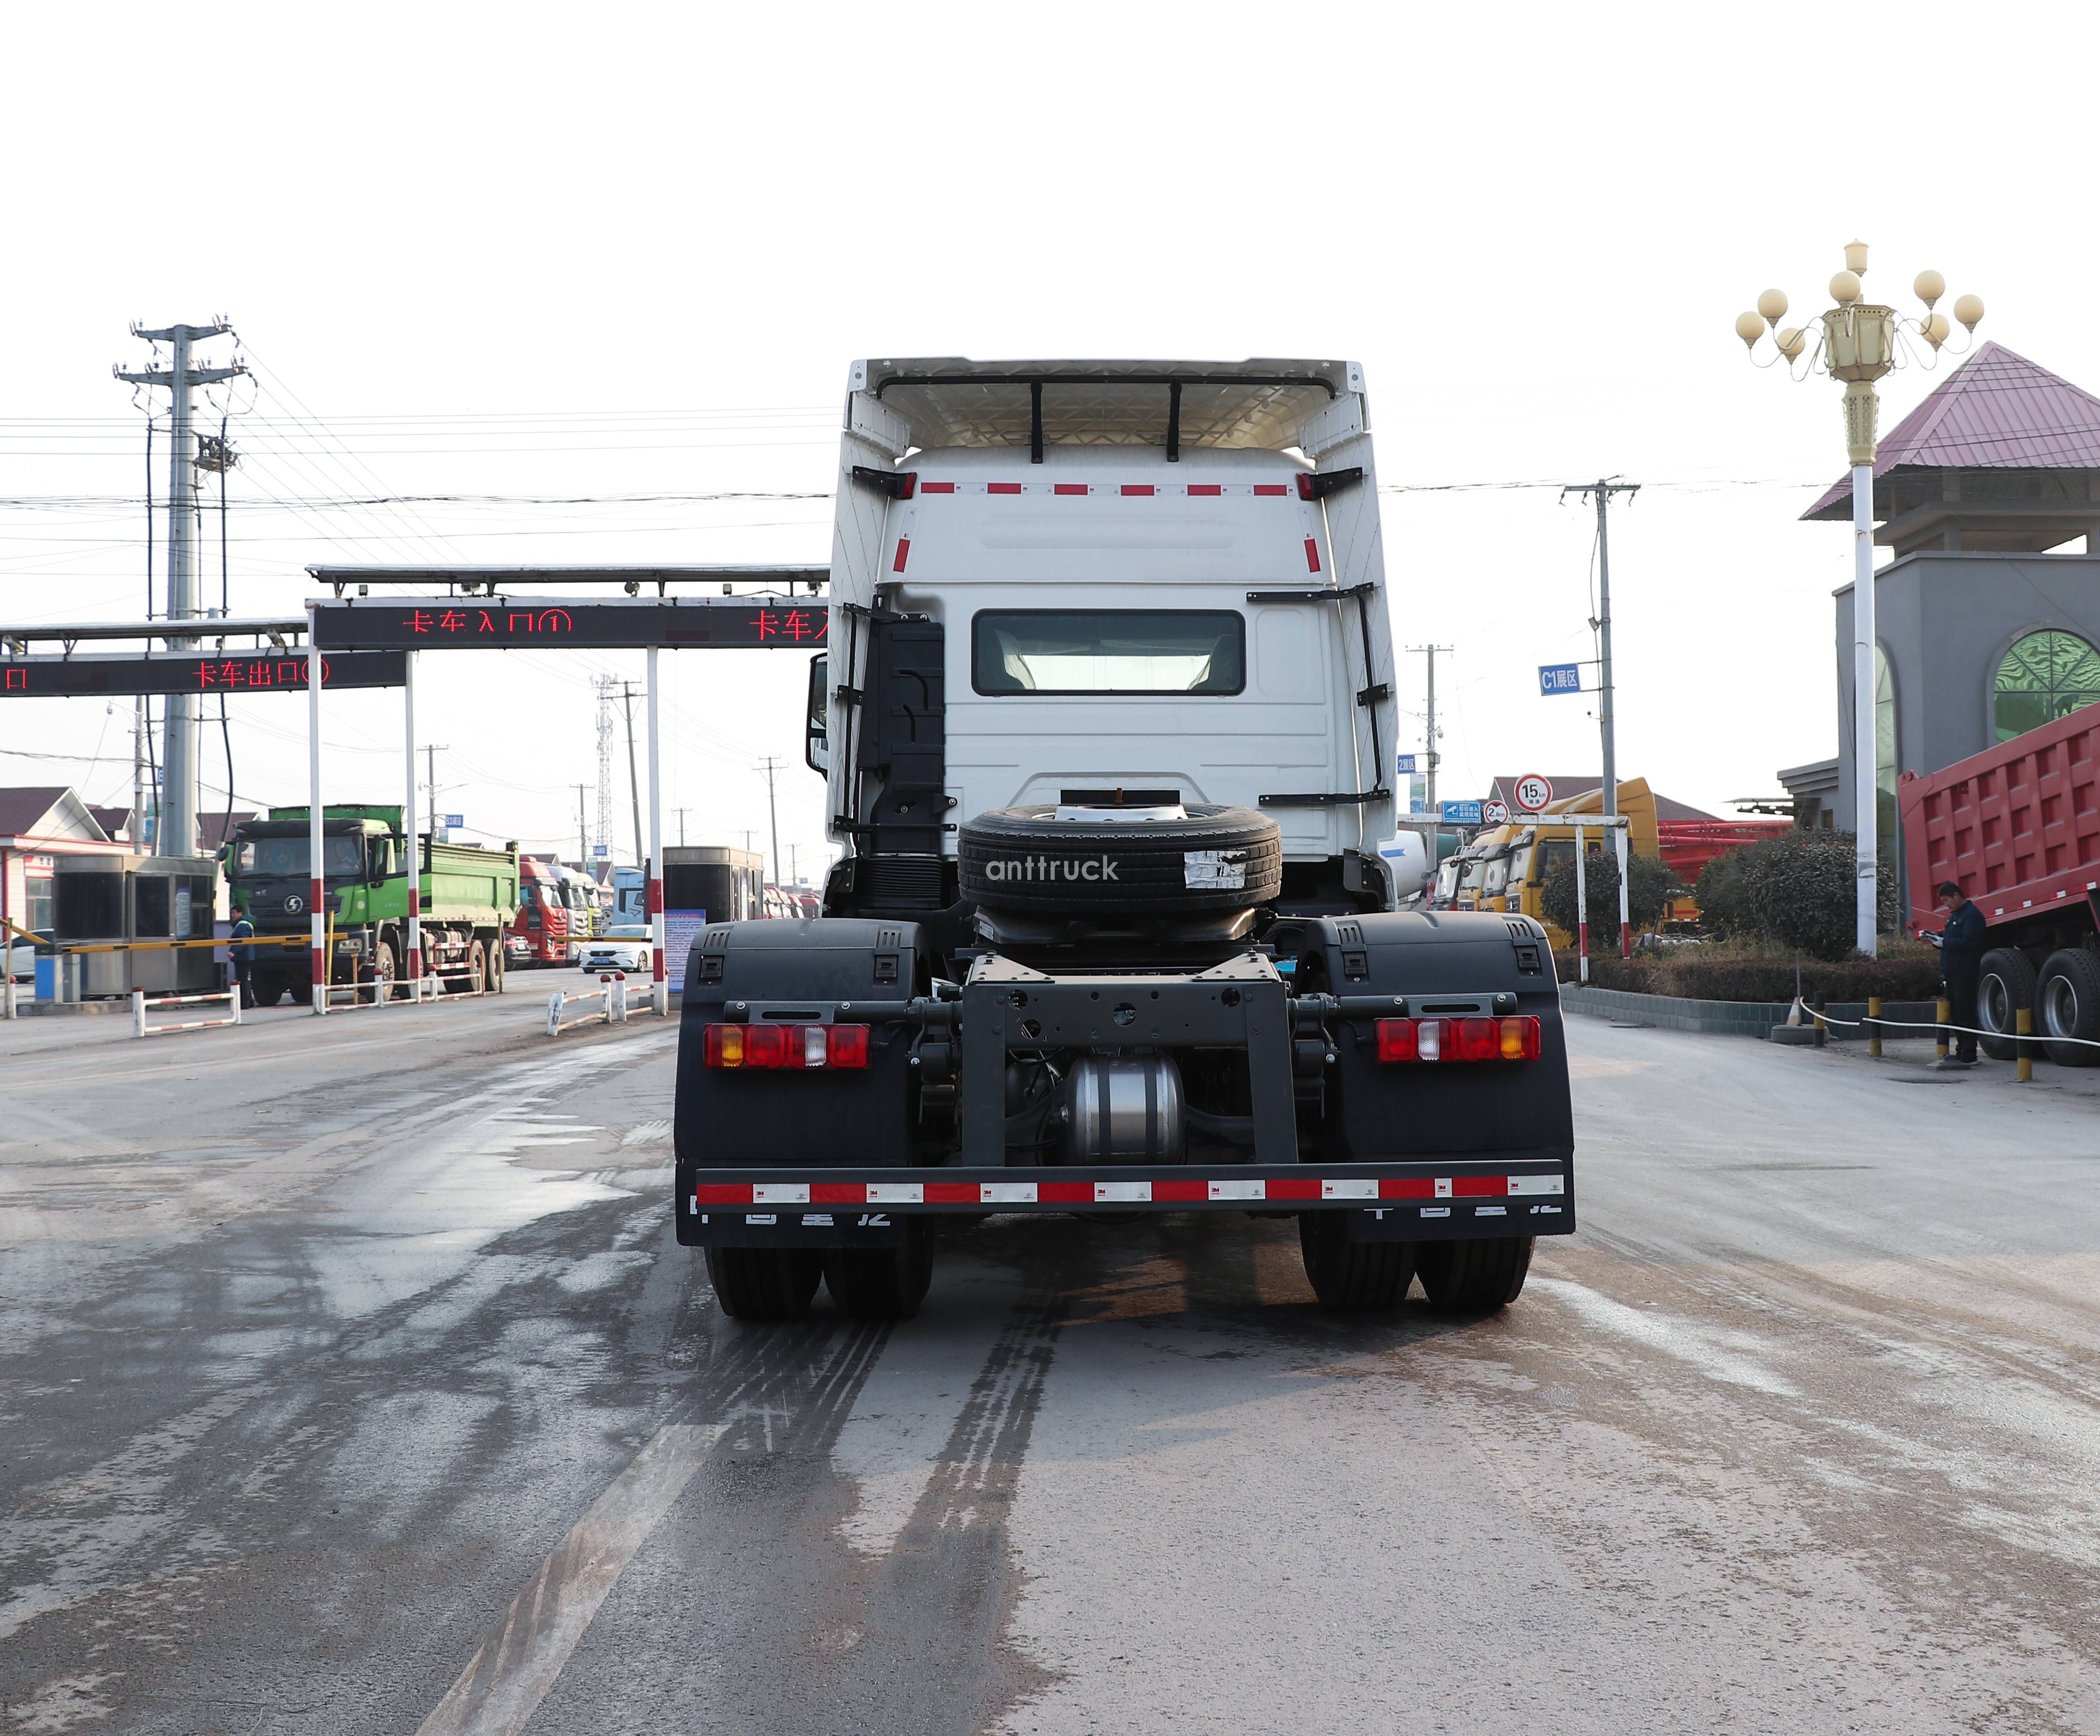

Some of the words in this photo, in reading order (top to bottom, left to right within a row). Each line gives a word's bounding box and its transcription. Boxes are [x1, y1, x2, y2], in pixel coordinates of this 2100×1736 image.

[192, 659, 330, 688] 卡车出口
[1542, 670, 1577, 689] C1展区
[1398, 758, 1415, 771] 2展区
